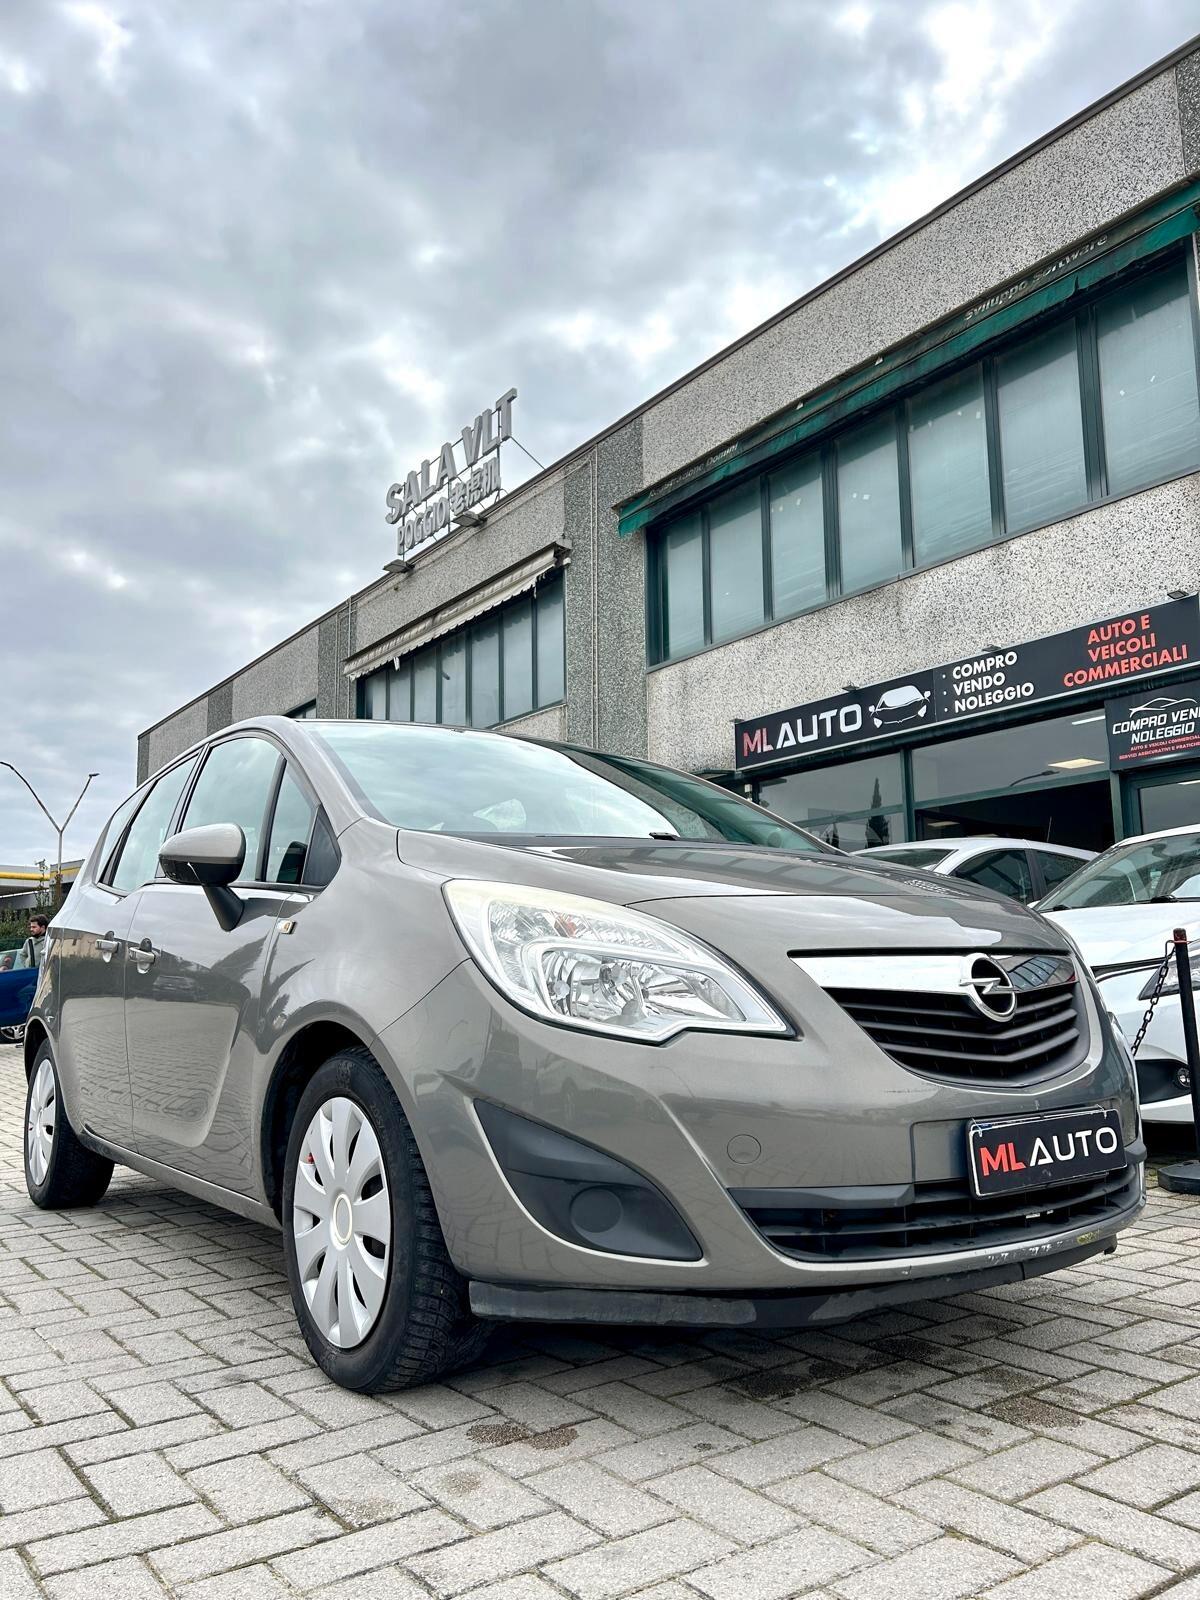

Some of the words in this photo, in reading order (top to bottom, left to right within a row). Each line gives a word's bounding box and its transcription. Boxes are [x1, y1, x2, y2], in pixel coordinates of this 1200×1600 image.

[385, 442, 457, 525] SALA
[461, 387, 518, 467] VLT
[397, 496, 450, 556] POGGIO
[1087, 619, 1136, 645] AUTO
[1140, 614, 1151, 630] E
[1088, 632, 1156, 662] VEICOLI
[952, 651, 1018, 680] COMPRO
[1063, 644, 1188, 687] COMMERCIALI
[952, 671, 1006, 696] VENDO
[954, 682, 1035, 713] NOLEGGIO
[742, 727, 774, 757] ML
[776, 703, 863, 750] AUTO
[1112, 713, 1168, 735] COMPRO
[1171, 706, 1200, 723] VEN
[1131, 722, 1196, 745] NOLEGGIO
[979, 1142, 1027, 1177] ML
[1030, 1126, 1118, 1167] AUTO
